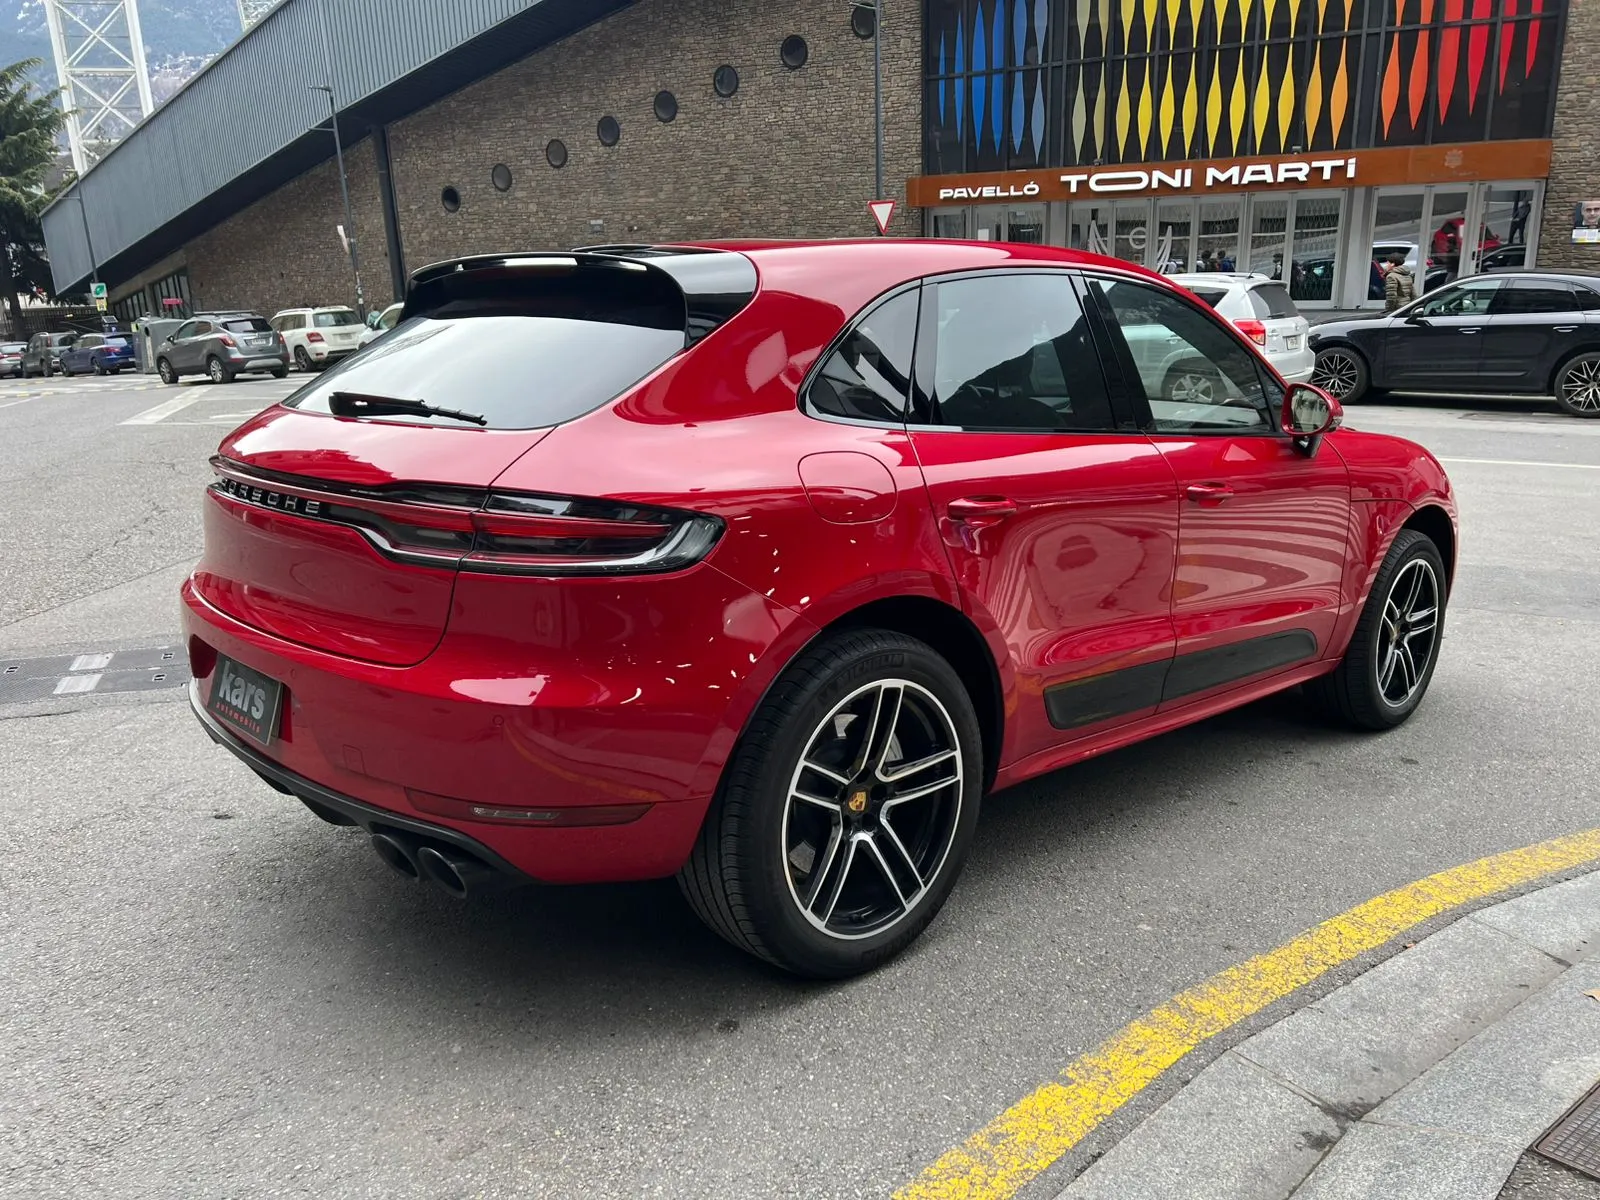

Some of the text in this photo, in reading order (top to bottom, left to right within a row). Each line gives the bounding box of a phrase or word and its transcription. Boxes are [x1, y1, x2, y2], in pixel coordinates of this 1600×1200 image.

[939, 181, 1040, 200] PAVELLÓ
[1060, 168, 1192, 193] TONI
[219, 478, 321, 514] PORSCHE
[218, 660, 266, 720] kars
